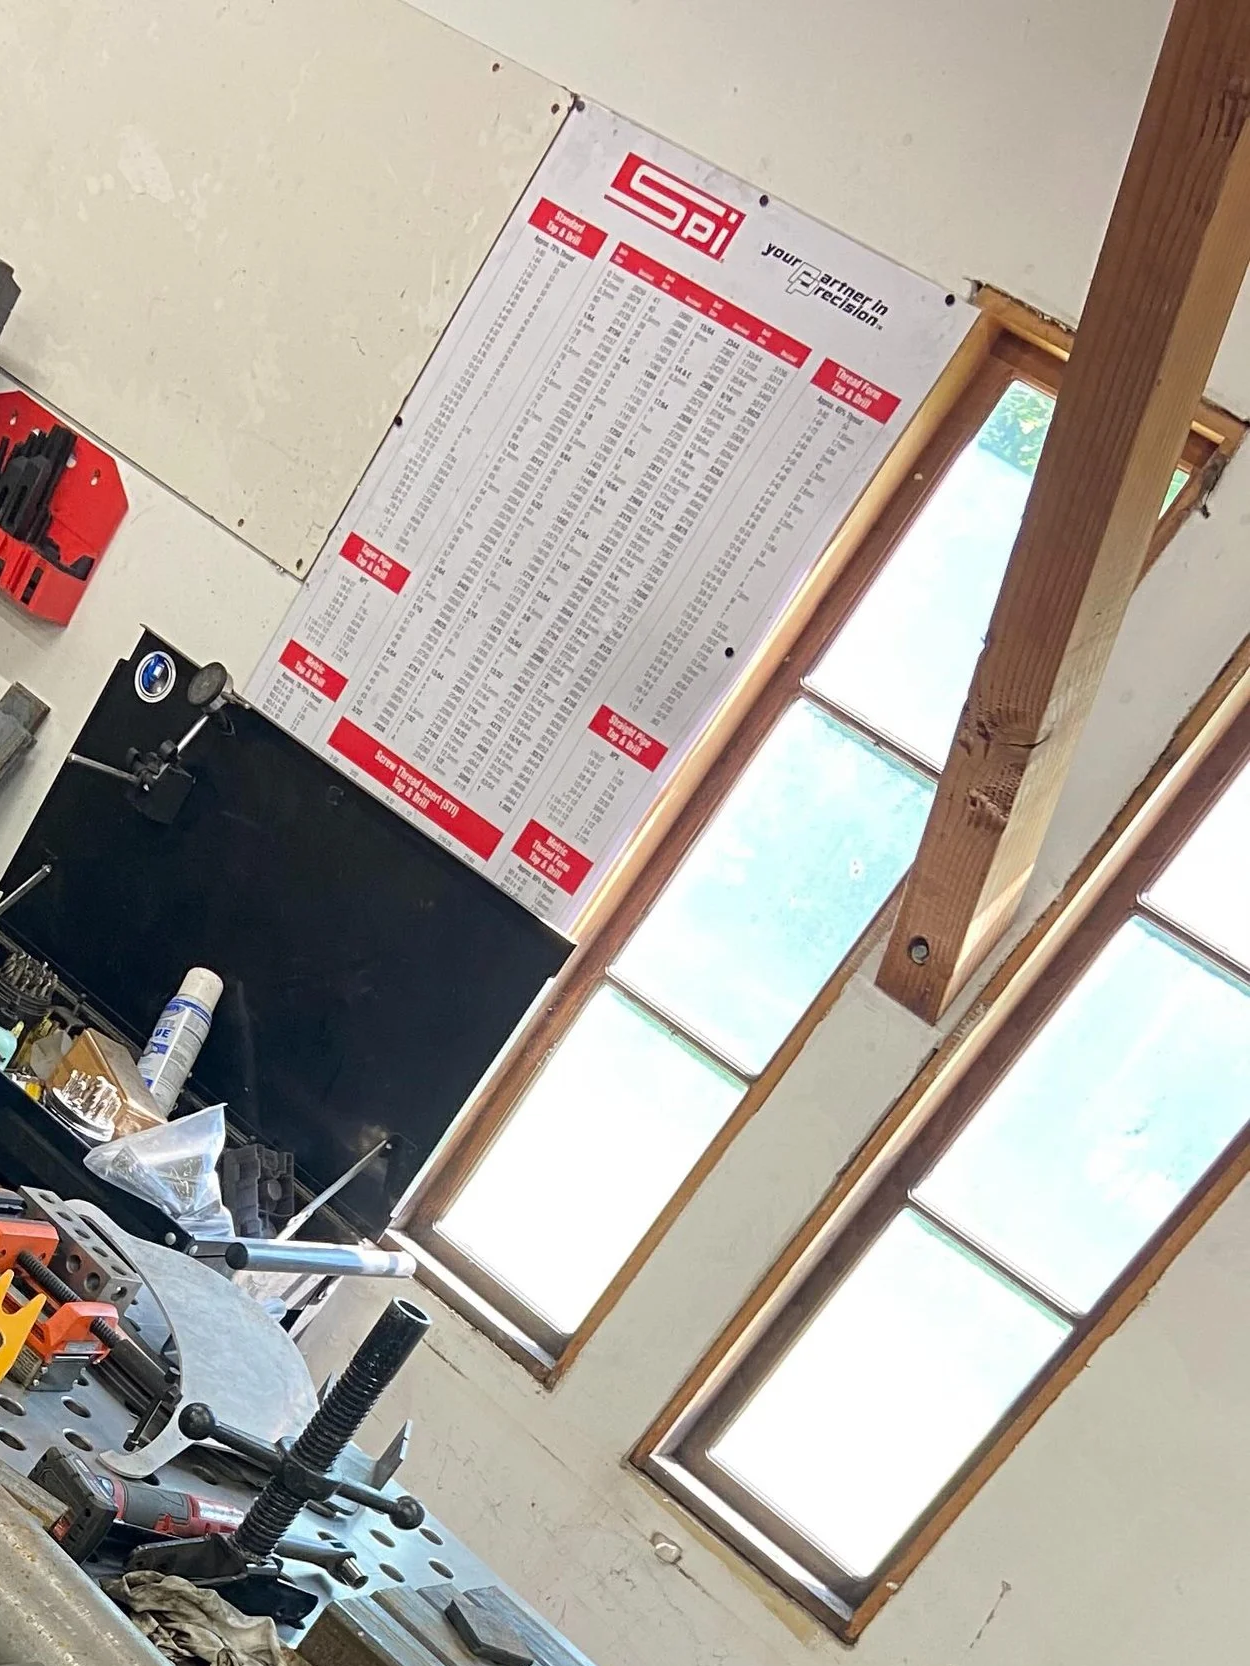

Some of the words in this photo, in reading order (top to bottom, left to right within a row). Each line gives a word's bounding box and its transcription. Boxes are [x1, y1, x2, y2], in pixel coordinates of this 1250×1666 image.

[543, 219, 561, 236] Tap
[556, 225, 567, 238] &
[564, 230, 582, 246] Drill
[553, 210, 586, 234] Standard
[761, 241, 801, 269] your
[867, 297, 889, 315] in
[828, 379, 848, 398] Tap
[843, 387, 855, 401] &
[851, 392, 872, 410] Drill
[835, 367, 864, 389] Thread
[860, 381, 883, 400] Form
[353, 552, 370, 569] Tap
[364, 559, 376, 572] &
[370, 564, 390, 581] Drill
[359, 542, 382, 561] Taper
[376, 554, 396, 571] Pipe
[291, 659, 308, 676] Tap
[302, 667, 314, 679] &
[308, 671, 328, 689] Drill
[303, 654, 329, 675] Metric
[603, 725, 622, 743] Tap
[616, 733, 629, 747] &
[624, 739, 643, 756] Drill
[606, 713, 639, 738] Straight
[633, 731, 654, 749] Pipe
[373, 749, 398, 771] Screw
[394, 764, 423, 789] Thread
[416, 782, 443, 805] Insert
[438, 798, 460, 818] (STI)
[390, 776, 409, 793] Tap
[402, 785, 415, 799] &
[410, 791, 431, 809] Drill
[530, 839, 558, 861] Thread
[550, 854, 572, 873] Form
[544, 835, 572, 857] Metric
[525, 850, 542, 866] Tap
[538, 858, 549, 870] &
[545, 863, 564, 880] Drill
